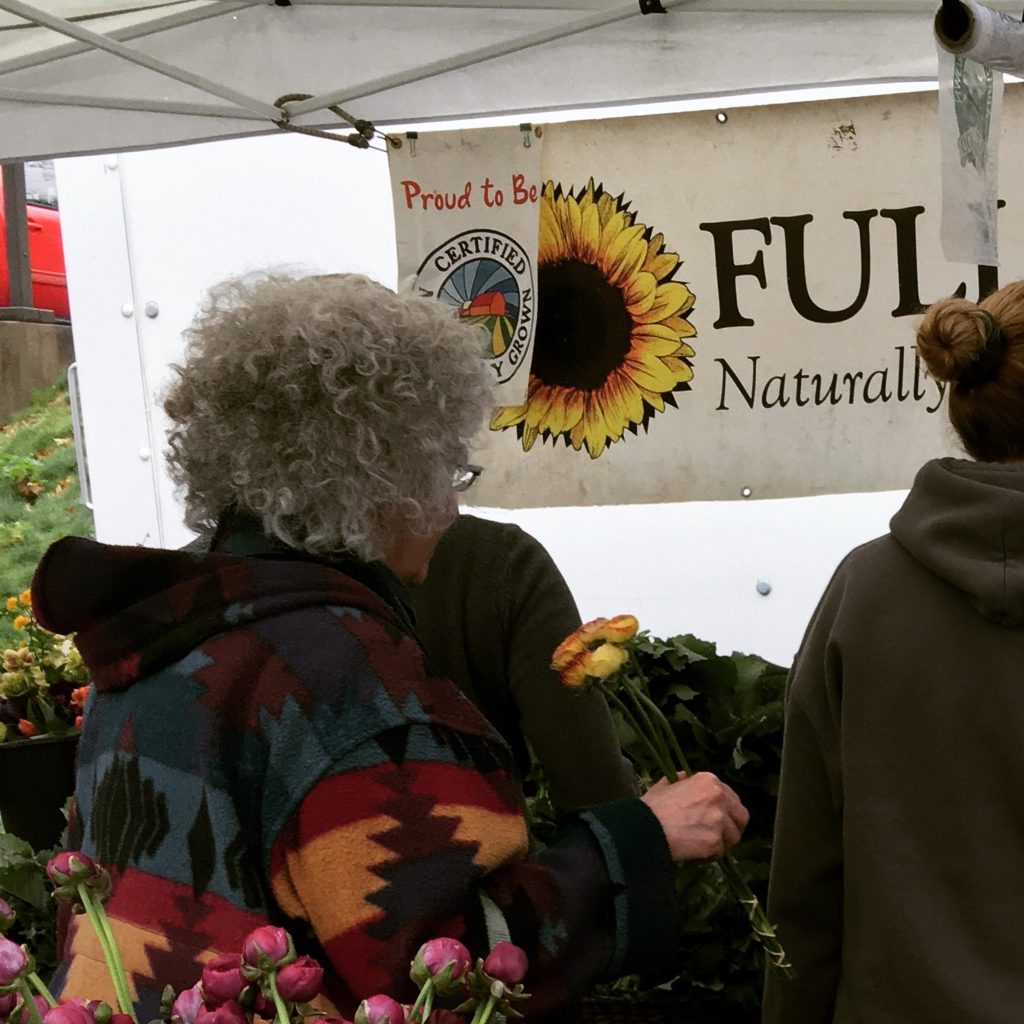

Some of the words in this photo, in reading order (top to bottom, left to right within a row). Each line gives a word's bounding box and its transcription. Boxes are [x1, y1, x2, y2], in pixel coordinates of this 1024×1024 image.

[400, 181, 472, 210] Proud
[480, 177, 505, 207] to
[511, 173, 539, 205] Be
[434, 235, 527, 275] CERTIFIED
[508, 287, 533, 366] GROWN
[713, 345, 948, 415] Naturally
